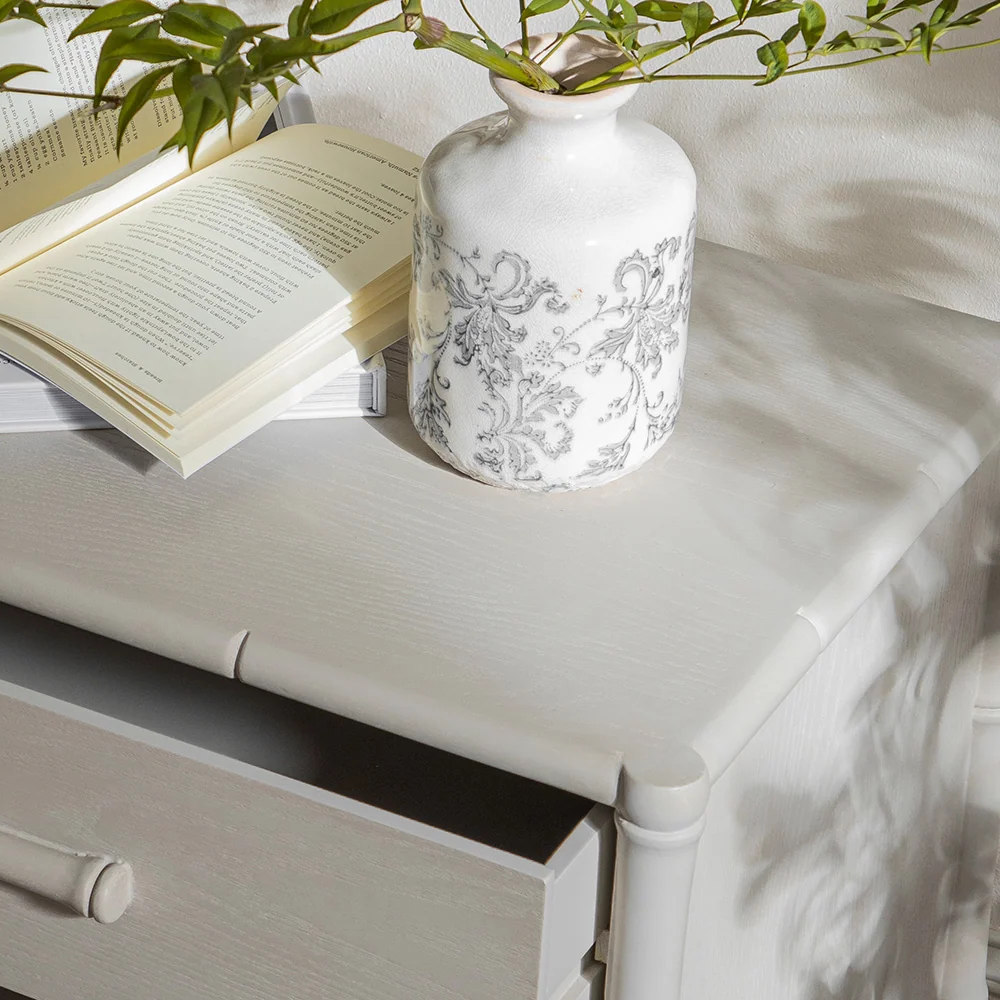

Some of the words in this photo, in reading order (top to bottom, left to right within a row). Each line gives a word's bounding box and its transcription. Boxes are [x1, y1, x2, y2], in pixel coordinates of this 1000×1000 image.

[45, 37, 55, 55] often
[55, 42, 68, 66] simple
[50, 55, 65, 84] changed
[64, 71, 73, 85] into
[71, 65, 79, 78] and
[0, 106, 12, 128] honey
[21, 116, 30, 127] oil
[47, 108, 58, 129] seeds
[66, 108, 77, 128] bread
[160, 104, 169, 123] stand
[25, 128, 35, 146] olive
[43, 126, 58, 161] Cornmeal
[53, 130, 66, 157] Sesame
[72, 129, 85, 155] favorite
[90, 132, 102, 158] Peasant
[0, 137, 13, 162] yogurt
[6, 129, 25, 172] tablespoons
[31, 146, 40, 160] cup
[40, 144, 49, 158] egg
[84, 139, 96, 162] finally
[0, 163, 8, 177] cup
[8, 162, 17, 177] cup
[80, 155, 89, 166] My
